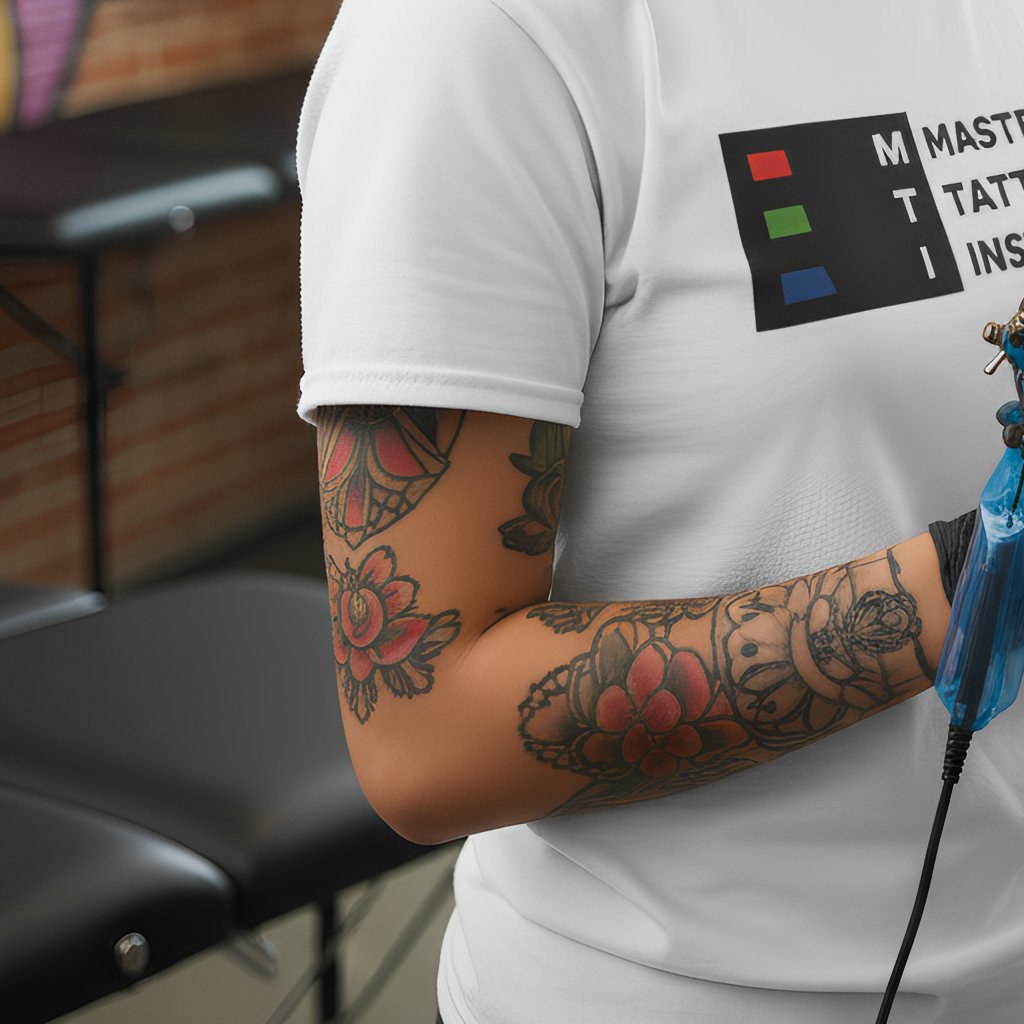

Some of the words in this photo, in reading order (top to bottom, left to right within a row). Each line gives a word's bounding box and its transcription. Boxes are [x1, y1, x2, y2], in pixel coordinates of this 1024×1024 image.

[871, 130, 910, 167] M
[892, 187, 918, 224] T
[919, 245, 937, 280] I
